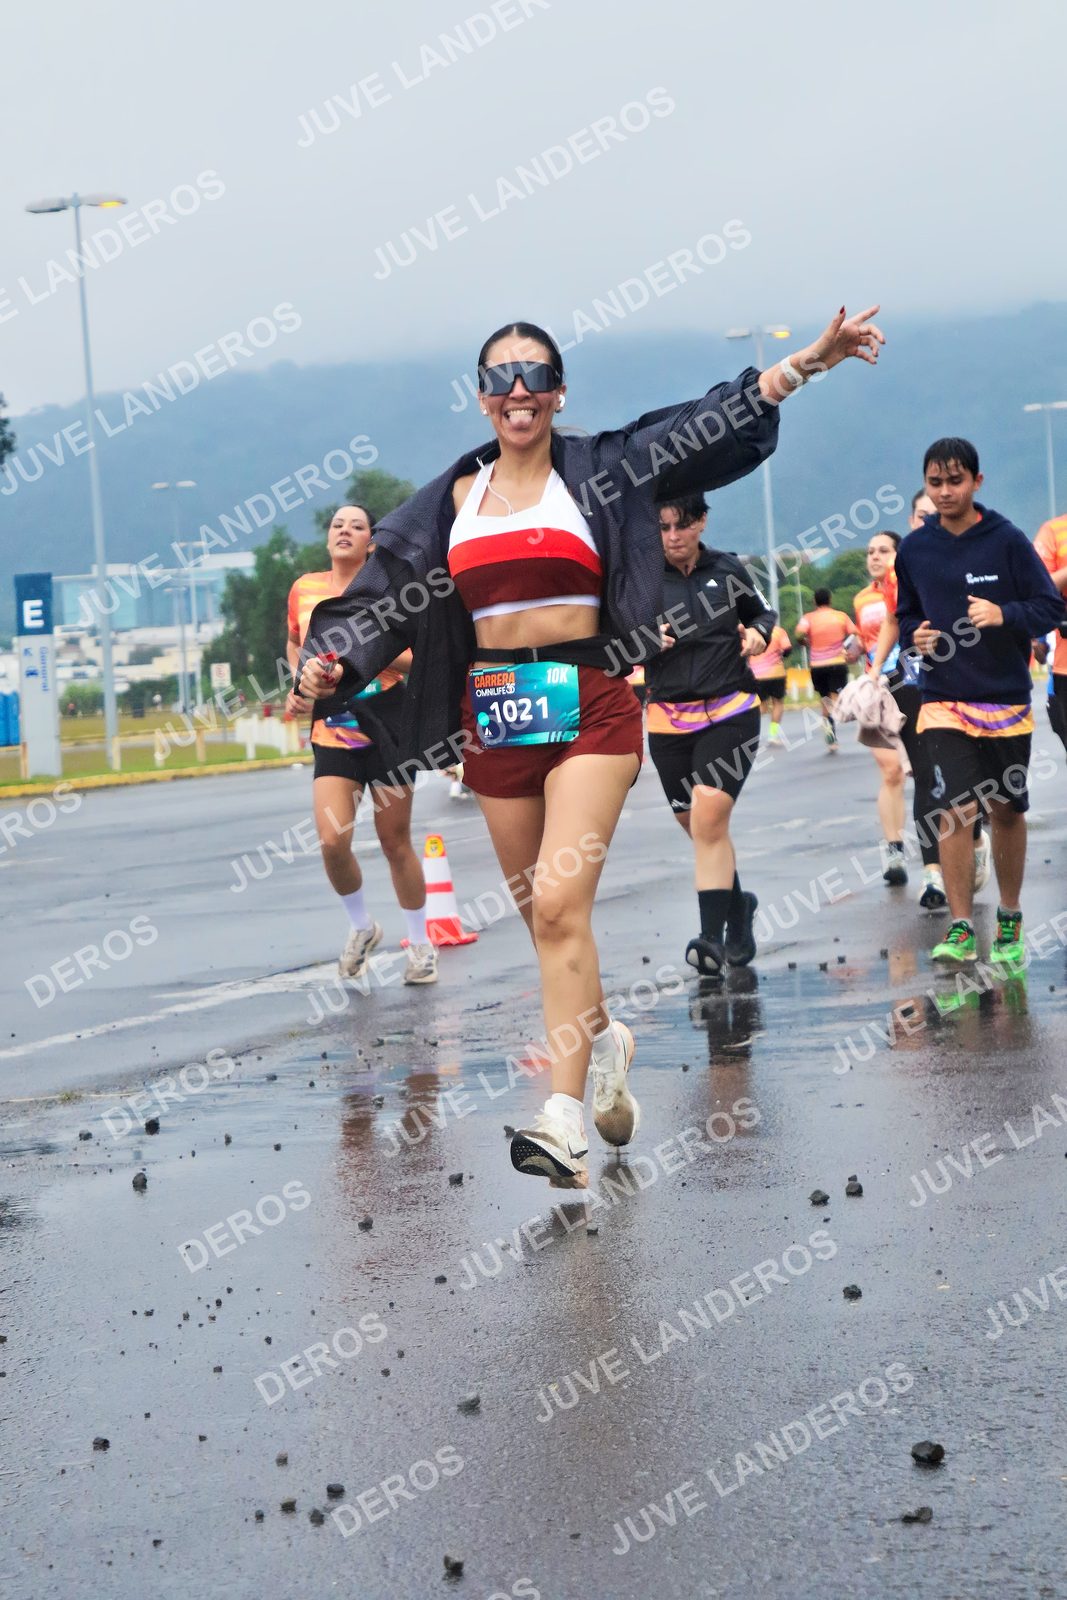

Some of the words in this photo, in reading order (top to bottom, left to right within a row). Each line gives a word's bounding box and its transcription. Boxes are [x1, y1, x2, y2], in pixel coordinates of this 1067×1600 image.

[23, 600, 44, 628] E
[474, 672, 515, 688] CARRERA
[547, 667, 568, 684] 10K
[490, 697, 548, 722] 1021
